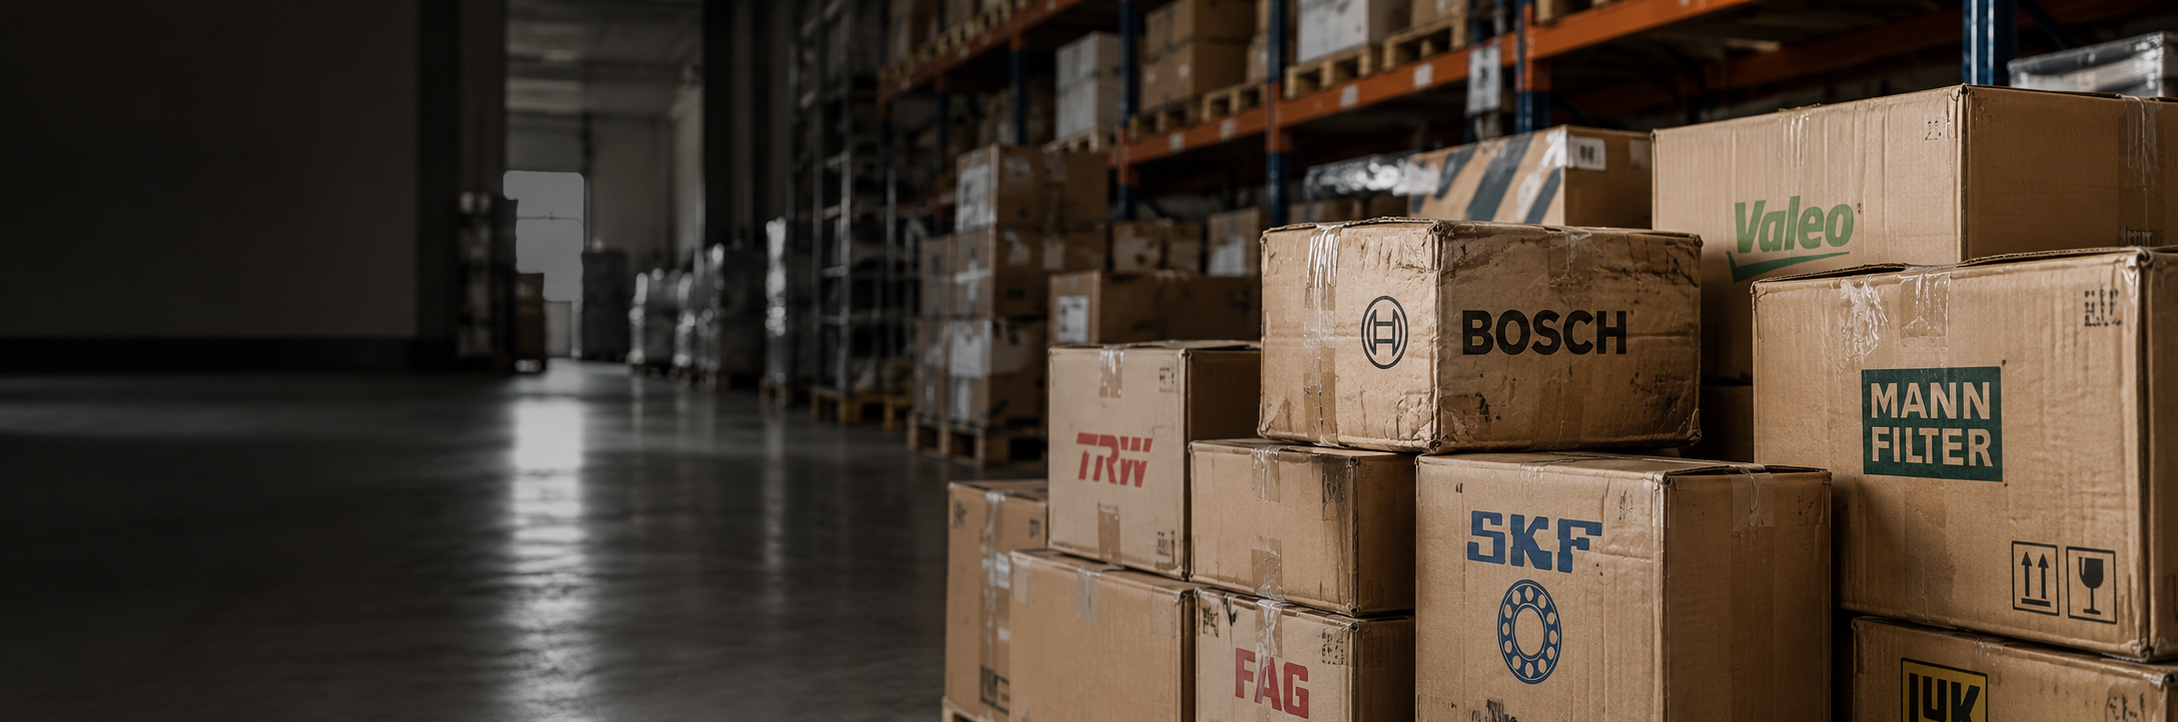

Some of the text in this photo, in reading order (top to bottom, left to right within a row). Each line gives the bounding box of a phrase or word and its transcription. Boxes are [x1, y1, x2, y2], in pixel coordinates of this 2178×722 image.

[1734, 195, 1855, 254] Valeo
[1462, 309, 1627, 356] BOSCH
[1870, 381, 1991, 420] MANN
[1076, 432, 1153, 488] TRW
[1871, 426, 1994, 467] FILTER
[1467, 510, 1603, 574] SKF
[1234, 647, 1310, 720] FAG
